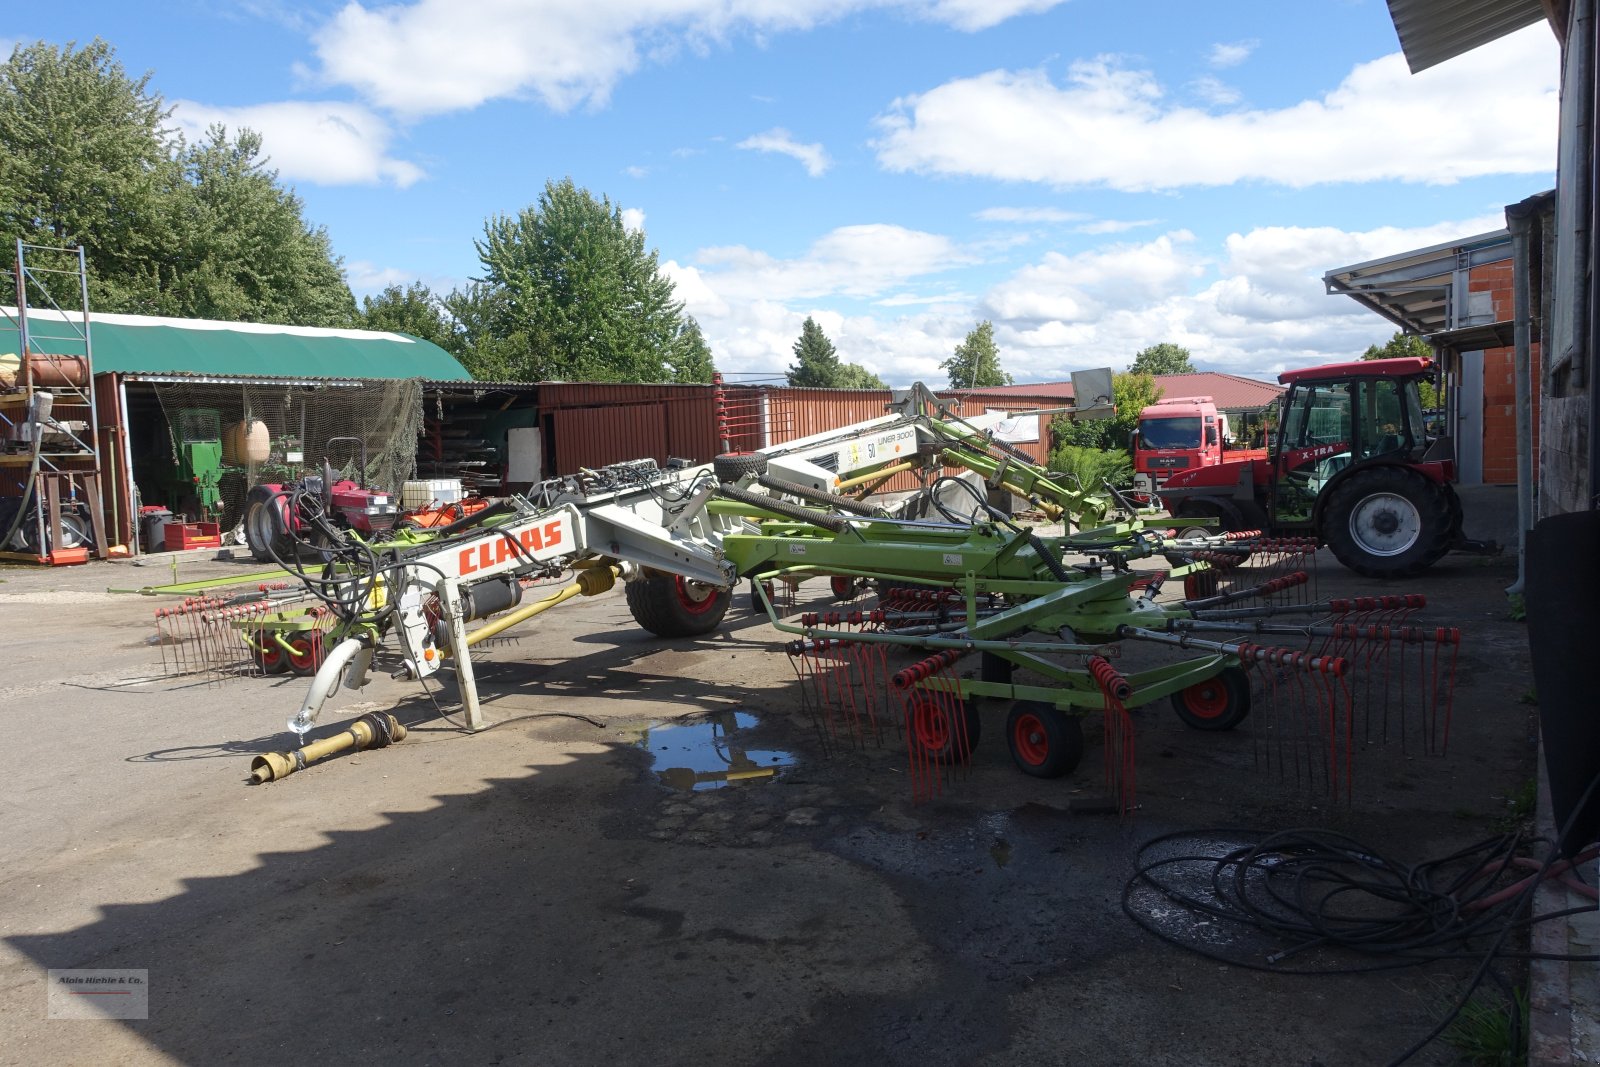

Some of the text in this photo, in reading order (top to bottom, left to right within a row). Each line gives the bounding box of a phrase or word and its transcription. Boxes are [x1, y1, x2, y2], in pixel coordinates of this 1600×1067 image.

[897, 430, 914, 441] 3000
[1302, 445, 1334, 460] X-TRA
[459, 520, 562, 577] CLAAS
